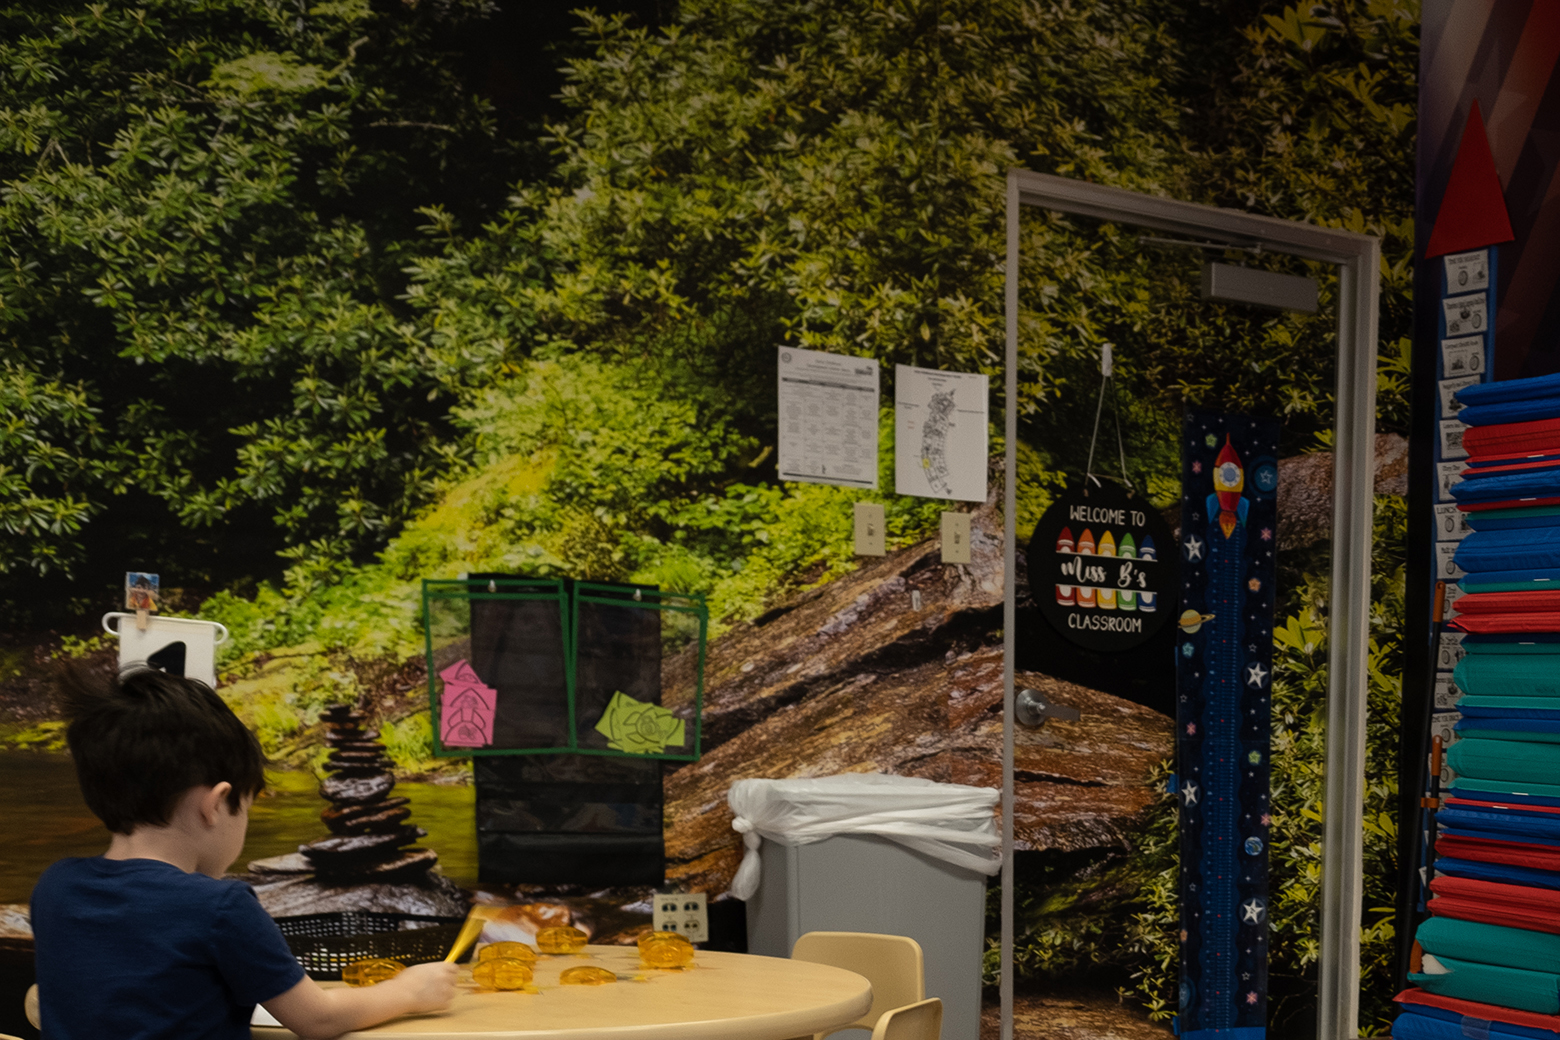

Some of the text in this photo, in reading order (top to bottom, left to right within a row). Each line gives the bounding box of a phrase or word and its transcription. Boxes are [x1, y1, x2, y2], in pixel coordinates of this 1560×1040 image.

[1069, 504, 1146, 527] WELCOME TO
[1060, 556, 1147, 588] Miss B's
[1067, 612, 1142, 633] CLASSROOM
